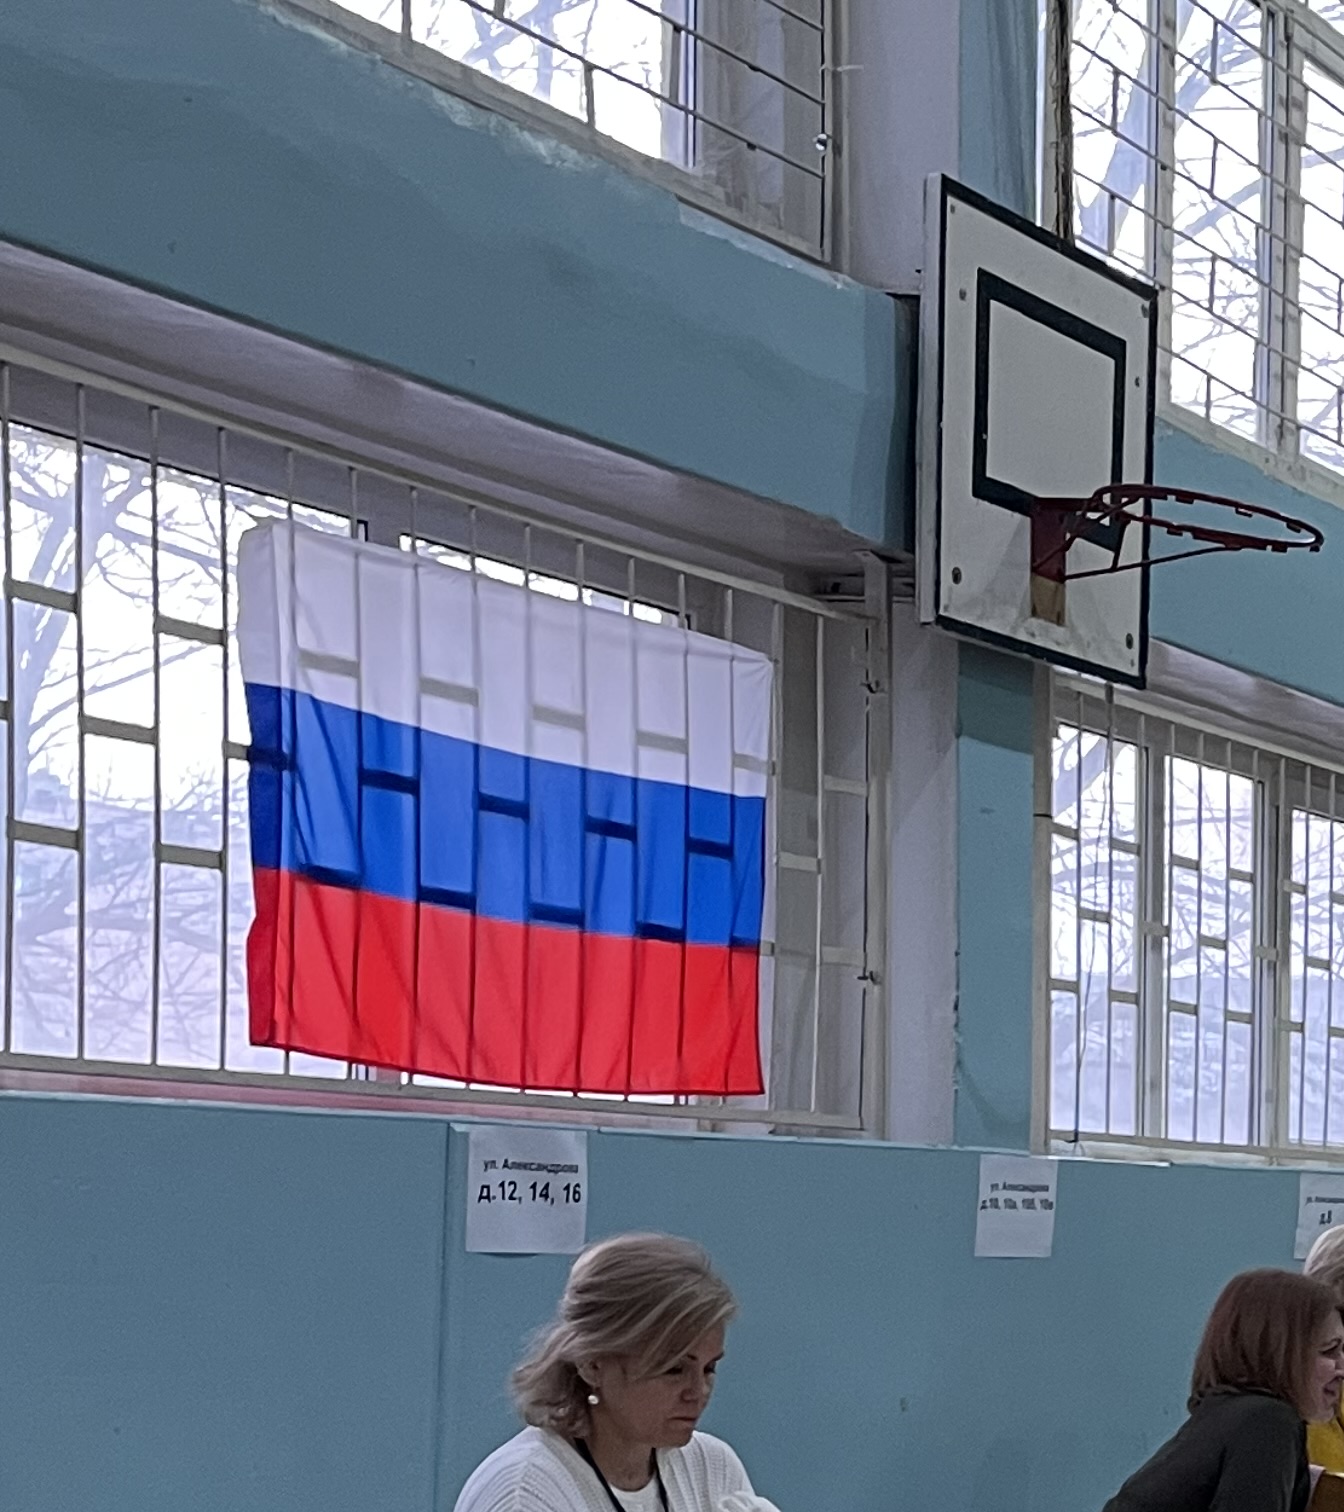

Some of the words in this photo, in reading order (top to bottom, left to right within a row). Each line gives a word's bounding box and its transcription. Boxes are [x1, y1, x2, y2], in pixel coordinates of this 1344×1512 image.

[478, 1181, 522, 1204] д.12,
[529, 1181, 554, 1205] 14,
[563, 1183, 581, 1203] 16
